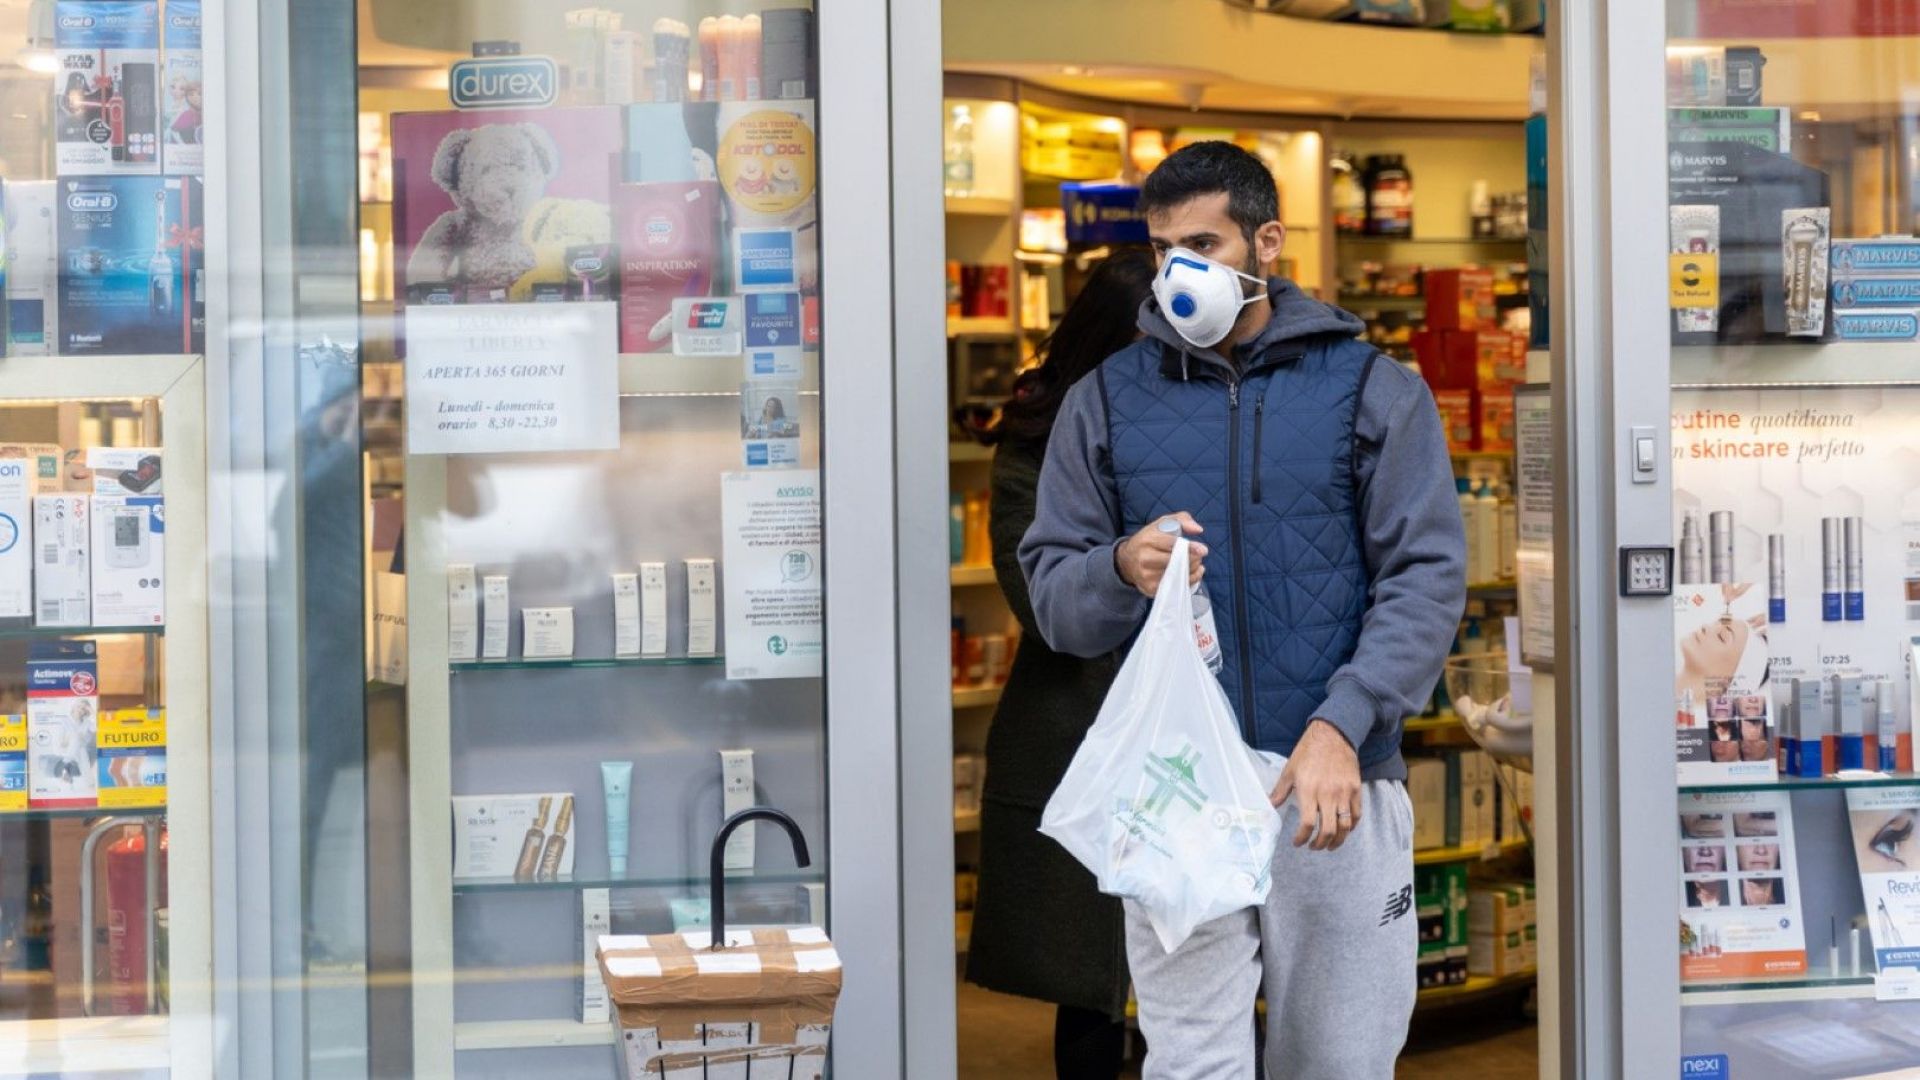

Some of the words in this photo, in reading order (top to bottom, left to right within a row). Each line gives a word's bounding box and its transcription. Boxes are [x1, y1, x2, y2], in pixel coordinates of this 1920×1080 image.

[461, 64, 547, 100] durex
[1702, 110, 1748, 120] MARVIS
[1684, 156, 1727, 165] MARVIS
[741, 248, 790, 258] AMERICAN
[1856, 247, 1920, 263] MARVIS
[625, 259, 698, 272] INSPIRATION
[1857, 283, 1920, 298] MARVIS
[750, 320, 794, 329] FAVOURITE
[1844, 319, 1911, 333] MARVIS
[423, 365, 481, 379] APERTA
[484, 365, 506, 378] 365
[510, 364, 566, 377] GIORNI
[494, 400, 555, 413] domenica
[438, 419, 478, 431] orario
[487, 417, 515, 430] 8,30
[1750, 408, 1854, 435] quotidiana
[1690, 439, 1790, 459] skincare
[1797, 439, 1865, 464] perfetto
[776, 487, 814, 497] AVVISO
[1822, 655, 1851, 665] 07:25
[34, 668, 73, 679] Actimove
[103, 731, 160, 744] FUTURO
[1683, 1057, 1719, 1073] nexi
